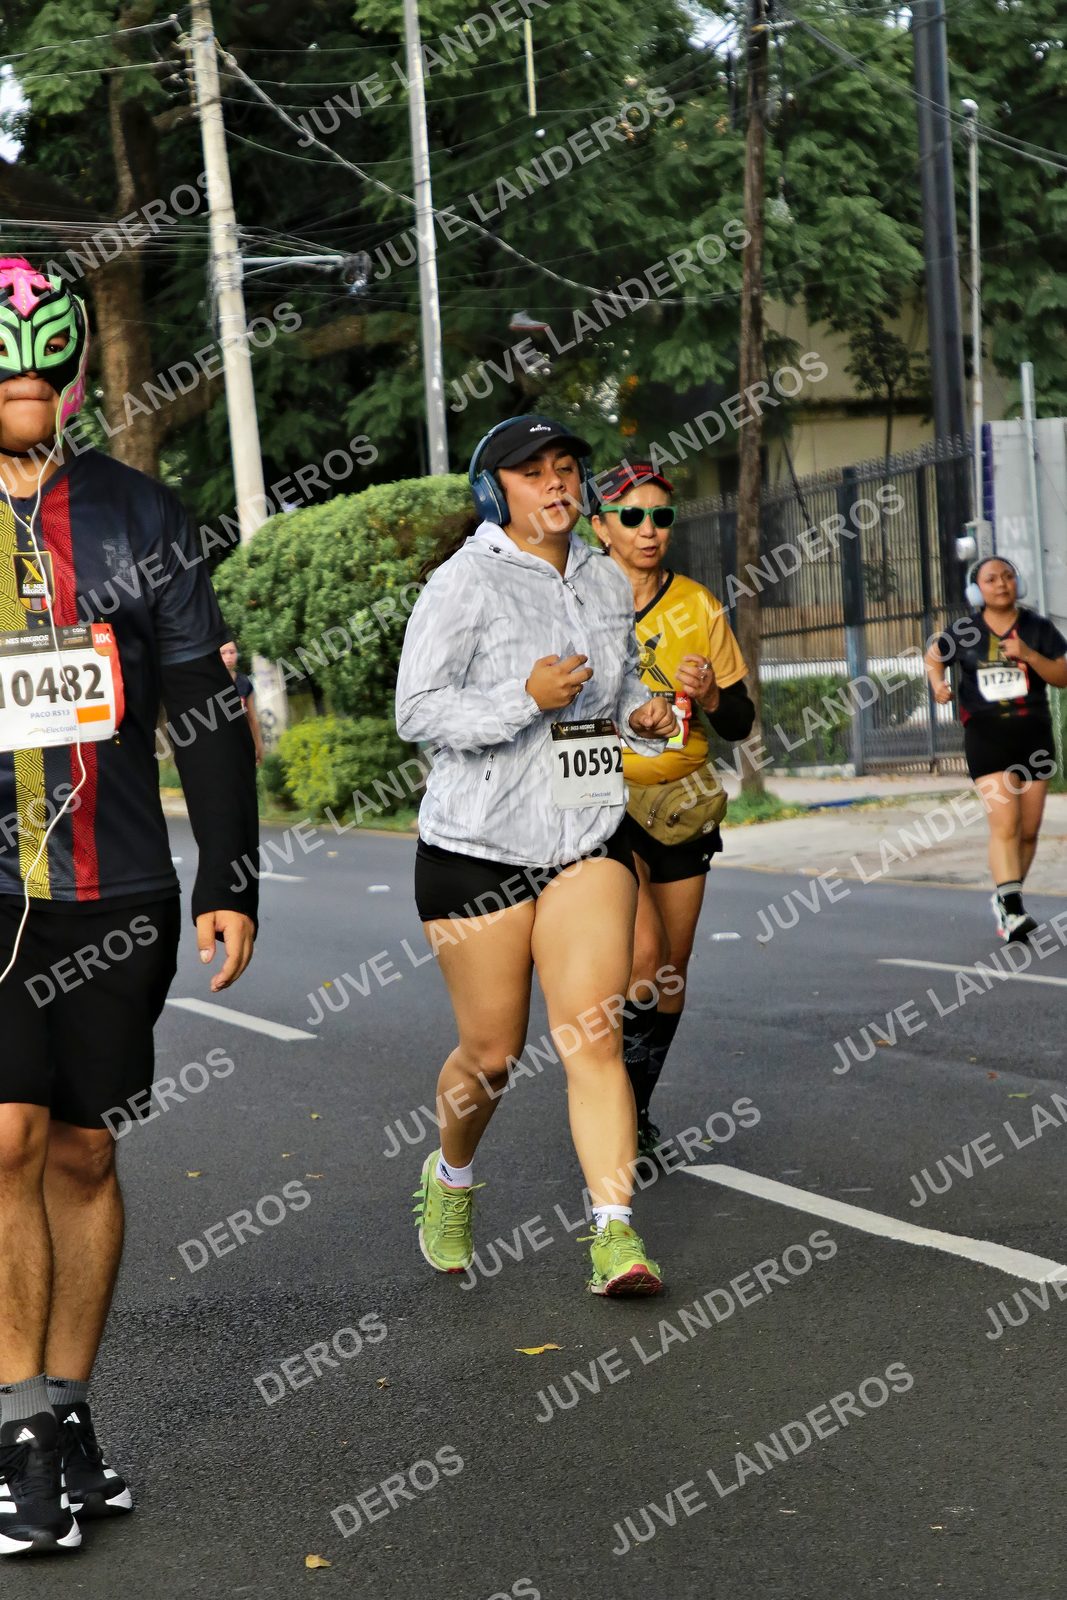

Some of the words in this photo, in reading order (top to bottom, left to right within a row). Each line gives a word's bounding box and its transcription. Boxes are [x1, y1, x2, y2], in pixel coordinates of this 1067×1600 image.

[20, 634, 49, 644] NEGROS
[982, 671, 1022, 686] 11227
[558, 745, 624, 778] 10592
